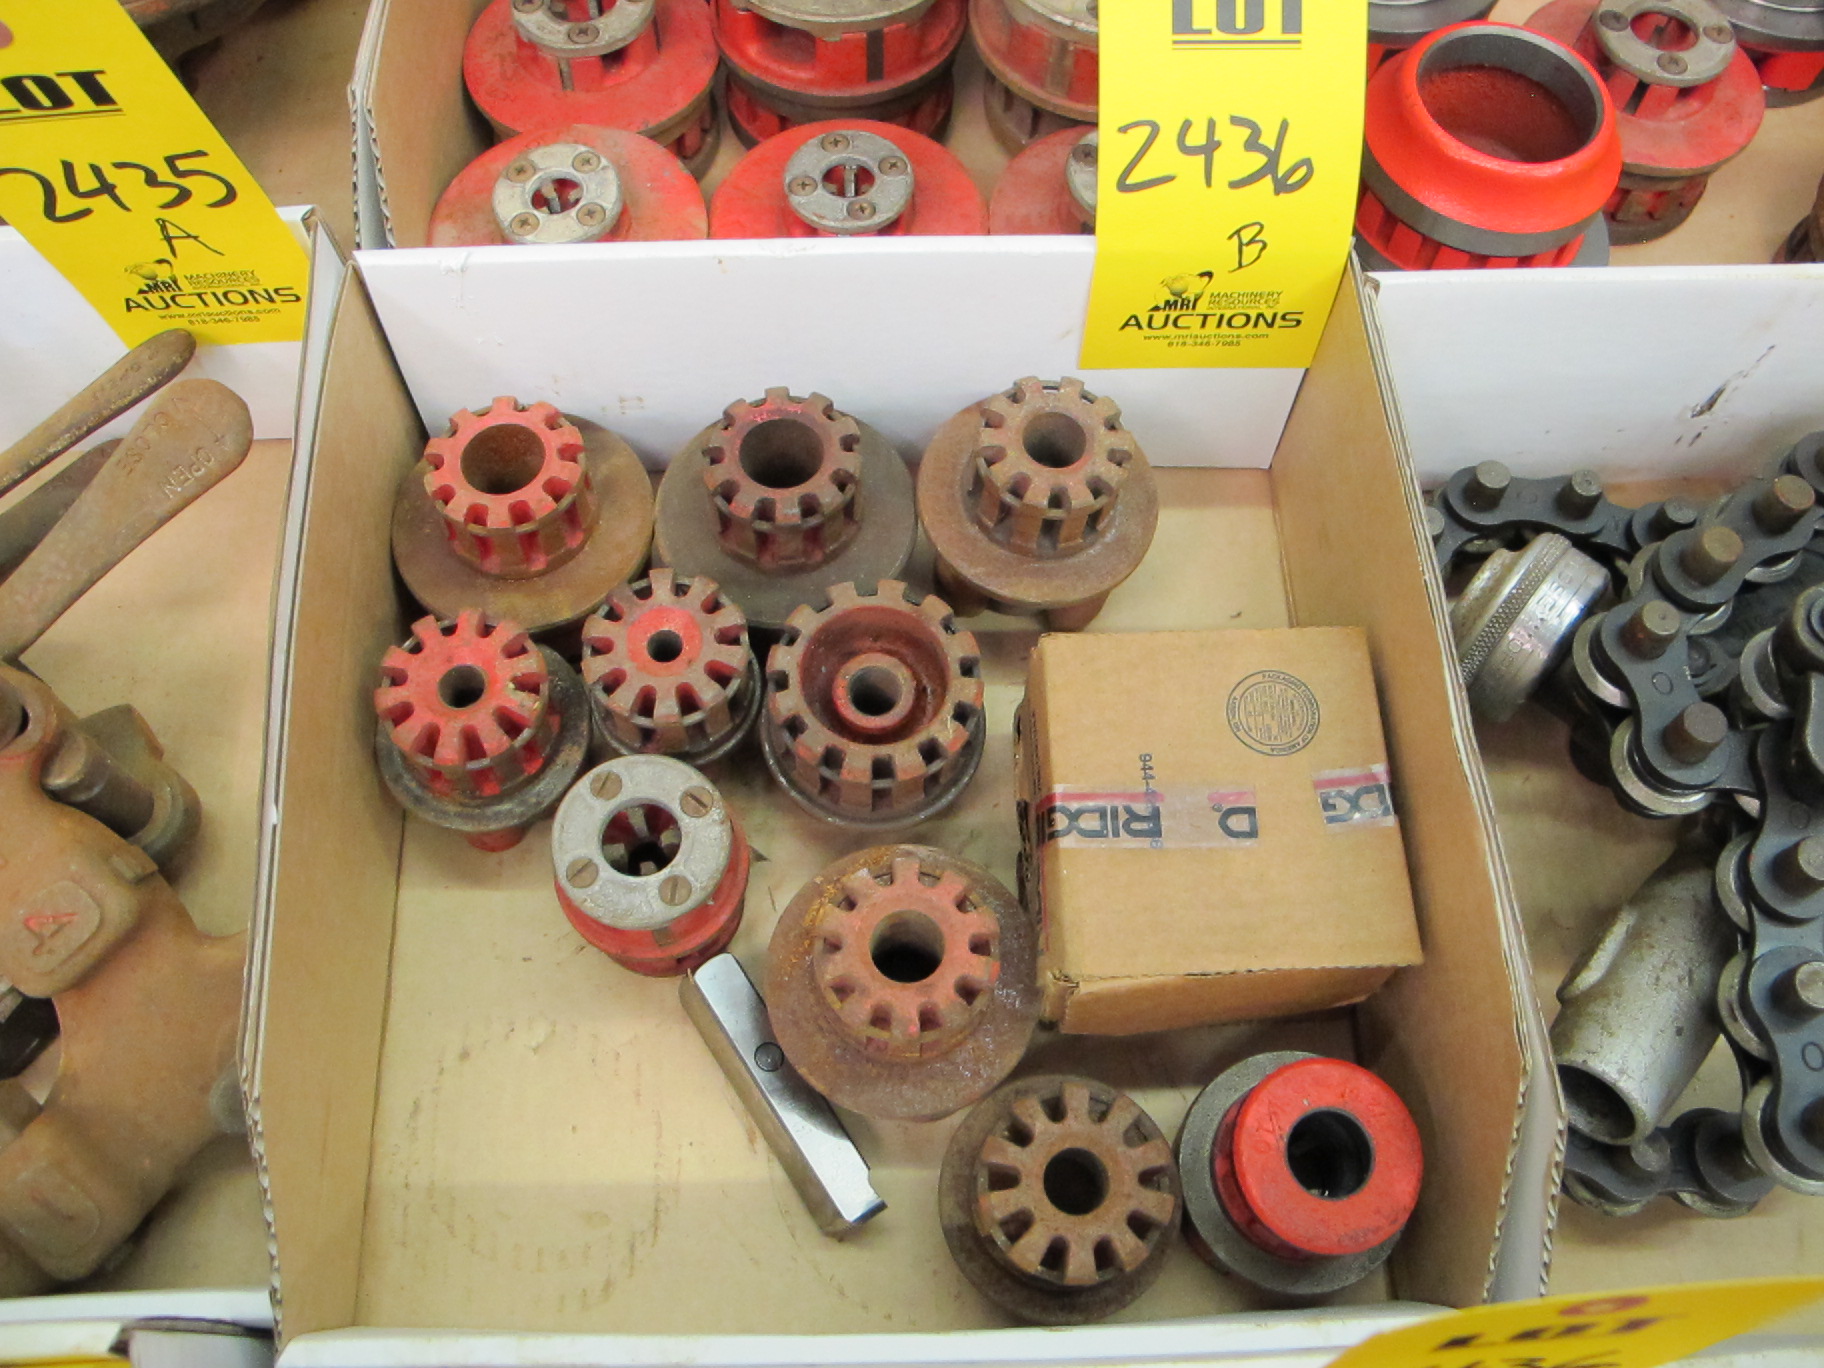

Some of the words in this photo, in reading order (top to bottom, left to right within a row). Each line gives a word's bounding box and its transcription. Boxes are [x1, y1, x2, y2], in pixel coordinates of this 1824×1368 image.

[0, 69, 119, 113] OT
[1116, 114, 1314, 196] 2436
[0, 149, 238, 223] 2435
[154, 217, 225, 259] A
[1227, 221, 1268, 273] B
[124, 286, 302, 313] AUCTIONS
[1163, 297, 1200, 312] MRI
[1209, 290, 1284, 300] MACHINERY
[1118, 311, 1305, 332] AUCTIONS
